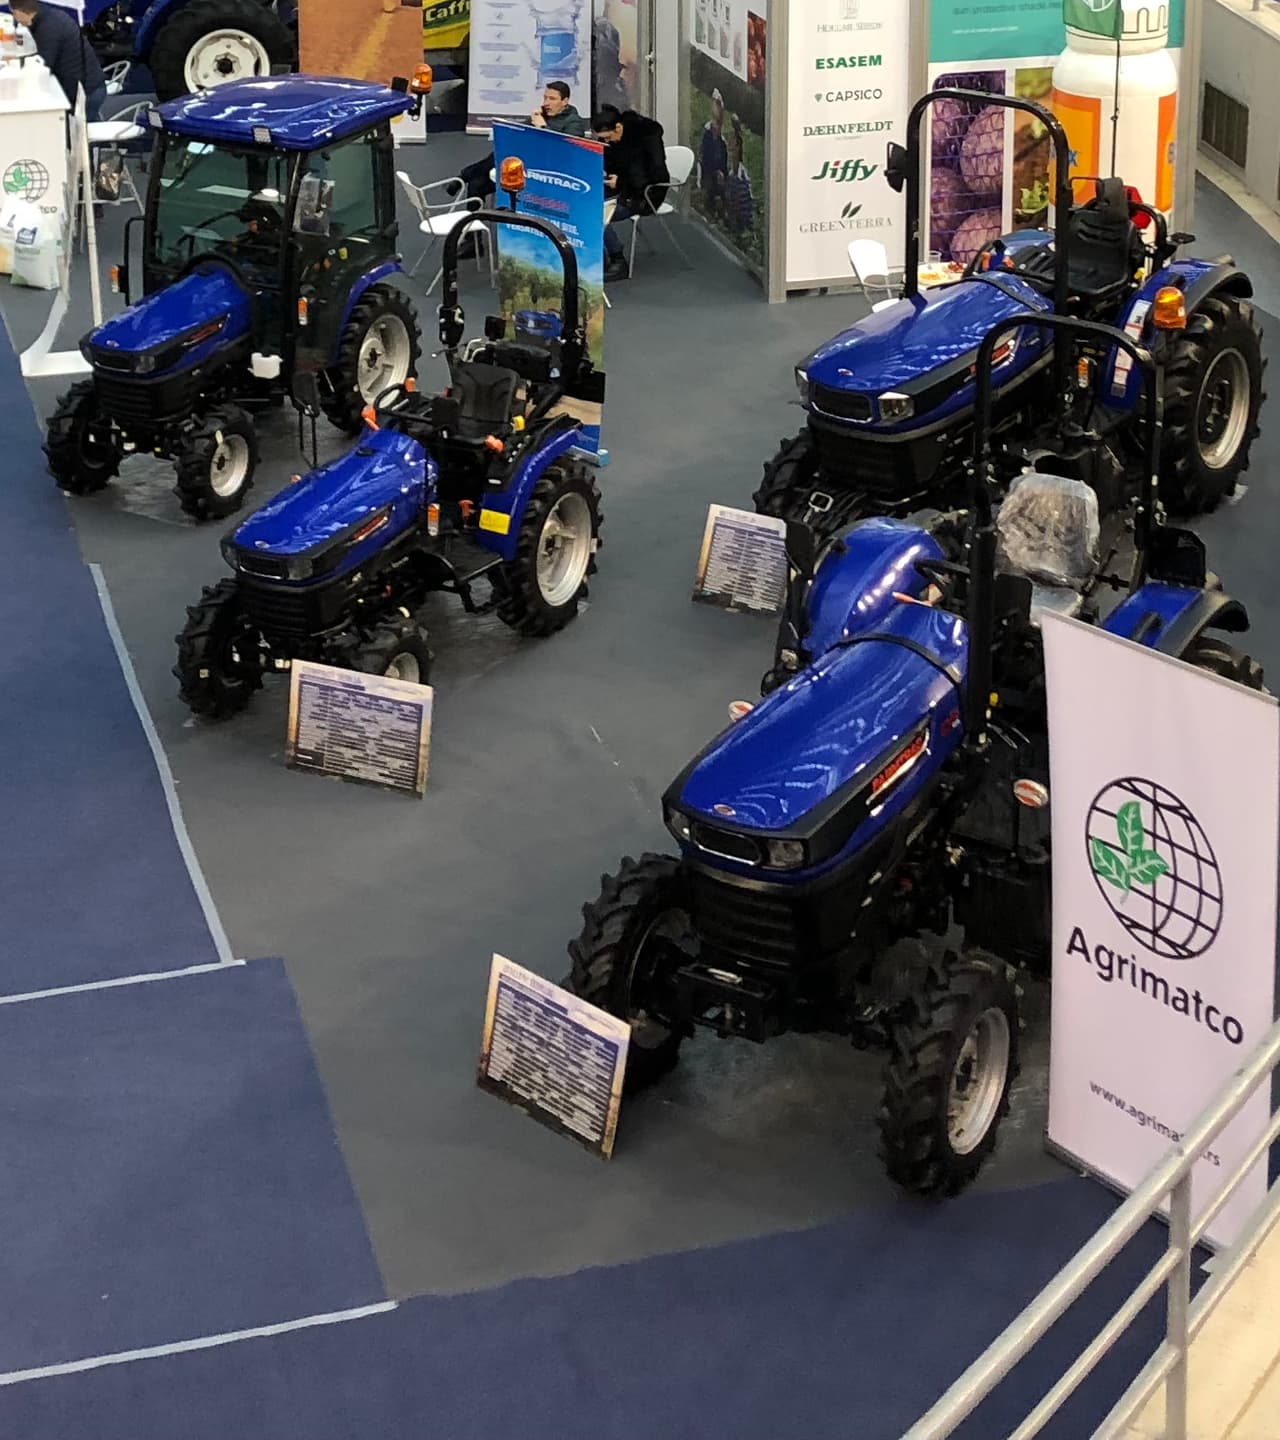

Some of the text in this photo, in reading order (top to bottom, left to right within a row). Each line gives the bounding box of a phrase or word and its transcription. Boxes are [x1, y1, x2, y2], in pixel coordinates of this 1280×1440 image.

[815, 54, 882, 70] ESASEM
[825, 88, 883, 103] CAPSICO
[802, 120, 894, 137] DÆHNFELDT
[811, 159, 879, 183] Jiffy
[799, 216, 893, 233] GREENTERRA
[1066, 926, 1244, 1045] Agrimatco
[1089, 1080, 1221, 1167] www.agrima.rs
